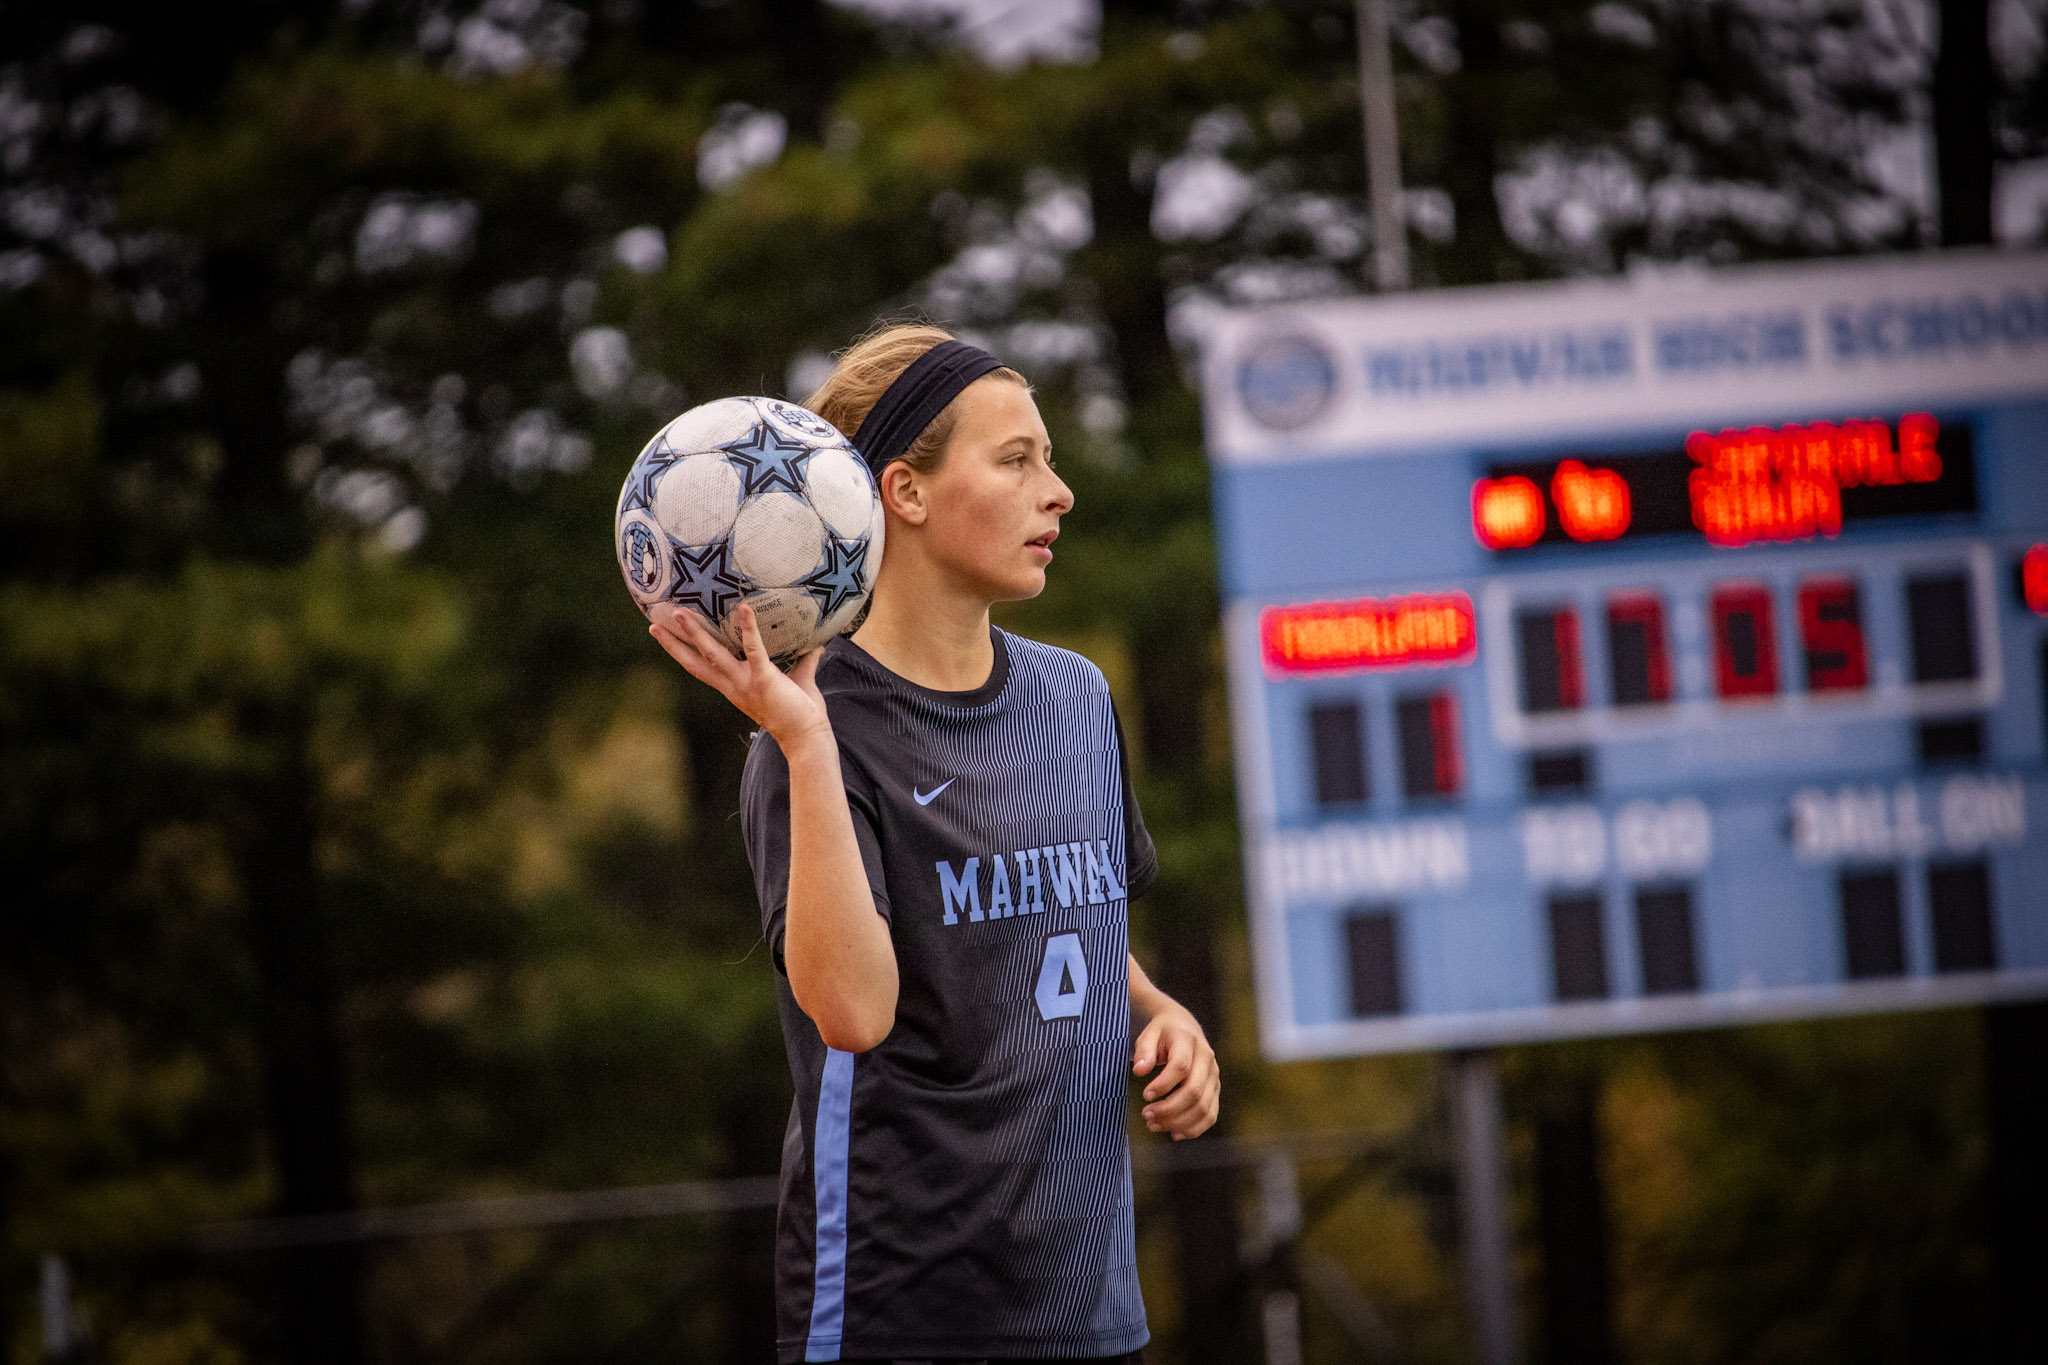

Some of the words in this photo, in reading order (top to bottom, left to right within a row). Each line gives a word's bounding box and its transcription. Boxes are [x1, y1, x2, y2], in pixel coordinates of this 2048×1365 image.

[1826, 290, 2048, 356] SCHOO
[1522, 804, 1606, 882] TO
[1616, 796, 1712, 878] GO
[1941, 776, 2026, 850] ON
[1269, 822, 1470, 898] DOWN
